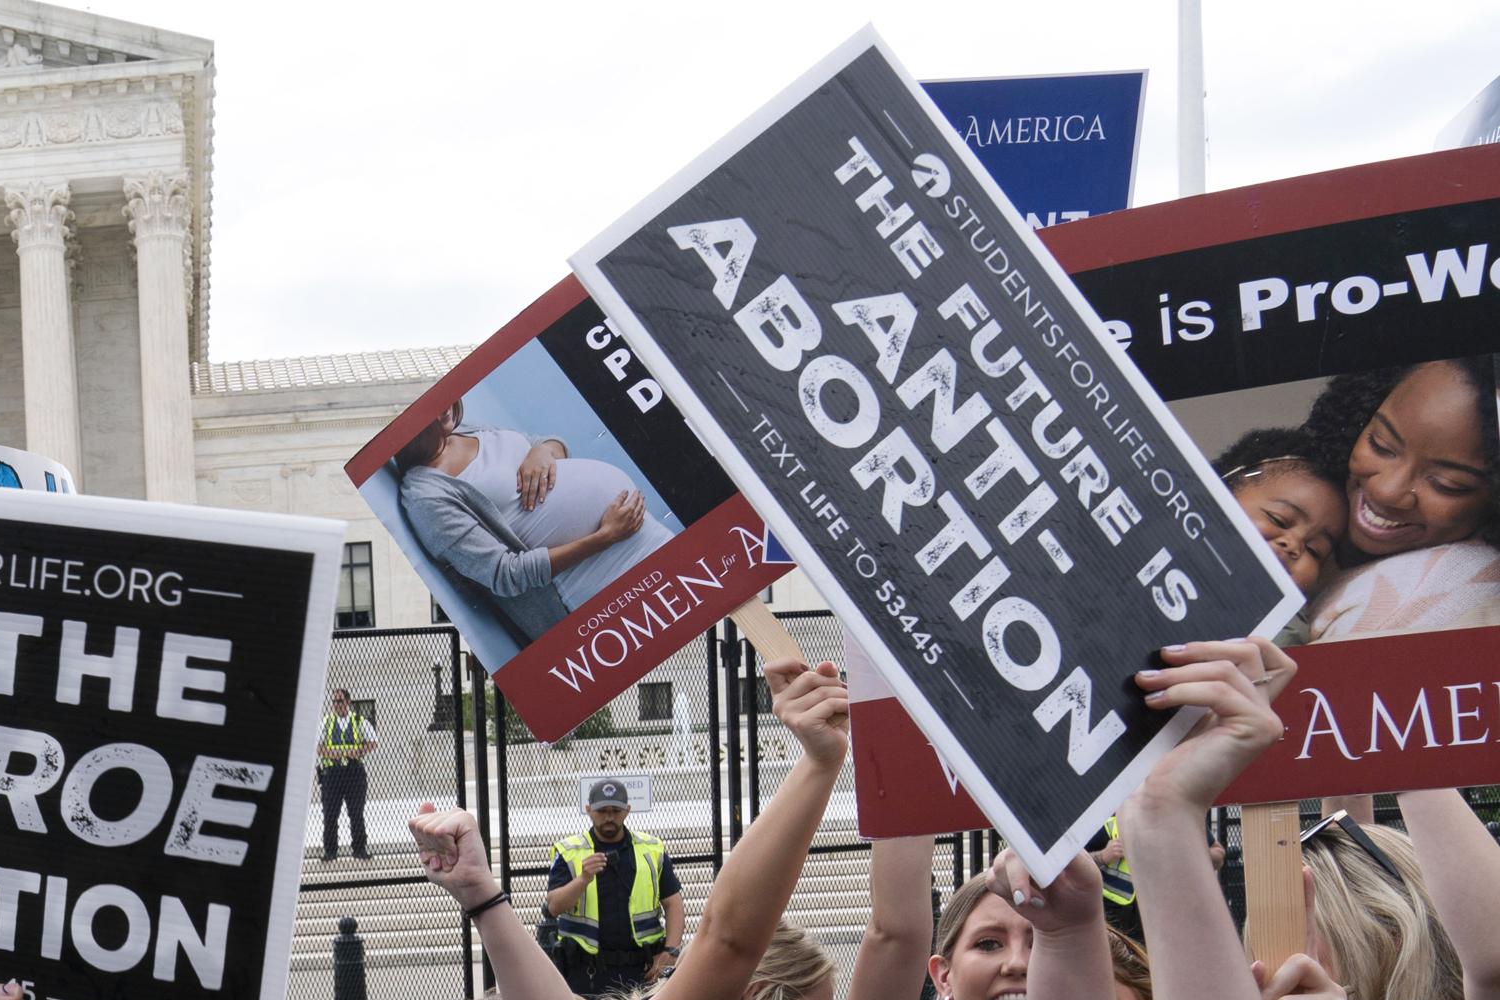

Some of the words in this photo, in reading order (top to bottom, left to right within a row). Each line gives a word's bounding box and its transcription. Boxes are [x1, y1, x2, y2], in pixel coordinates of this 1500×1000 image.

[964, 114, 1106, 147] AMERICA
[831, 292, 1074, 574] ANTI-
[834, 136, 945, 280] THE
[937, 282, 1142, 547] FUTURE
[1136, 547, 1198, 622] IS
[945, 195, 1206, 540] STUDENTSFORLIFE.ORG
[1159, 293, 1215, 346] is
[577, 570, 663, 637] CONCERNED
[667, 217, 1128, 776] ABORTION
[752, 413, 805, 480] TEXT
[800, 480, 850, 541] LIFE
[846, 537, 878, 579] TO
[875, 580, 944, 666] 53445
[548, 557, 724, 694] WOMEN
